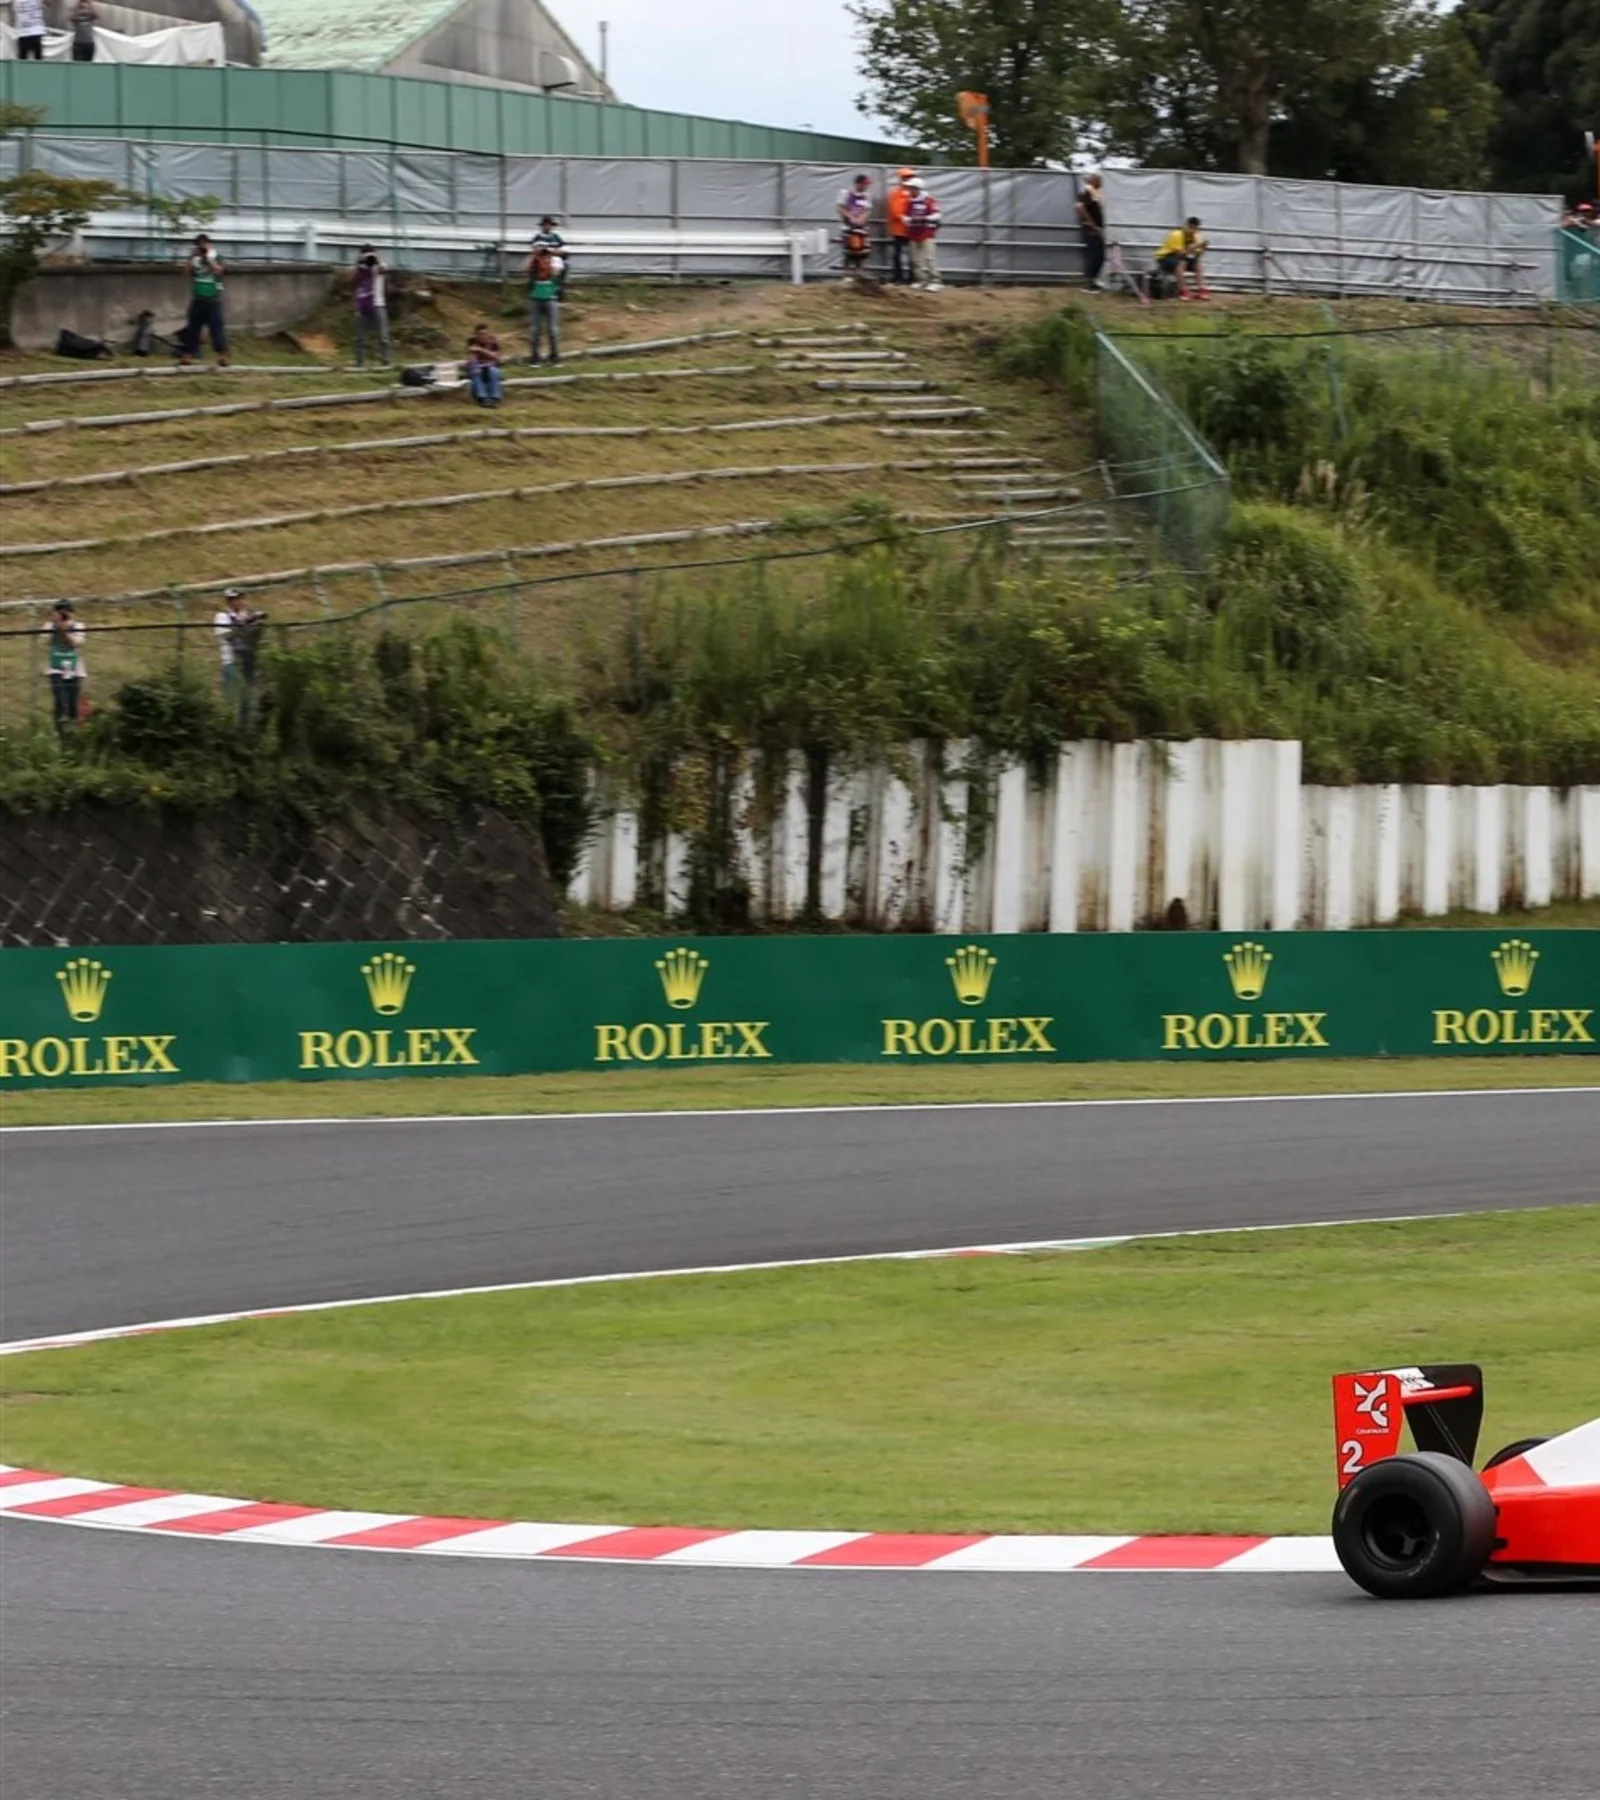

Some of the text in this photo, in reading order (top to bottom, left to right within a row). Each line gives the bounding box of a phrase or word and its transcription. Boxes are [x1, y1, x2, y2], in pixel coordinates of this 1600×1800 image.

[594, 1021, 772, 1062] ROLEX
[882, 1017, 1054, 1056] ROLEX
[1162, 1012, 1328, 1051] ROLEX
[1434, 1007, 1593, 1045] ROLEX
[0, 1035, 181, 1077] ROLEX
[299, 1028, 479, 1069] ROLEX
[1341, 1440, 1363, 1473] 2
